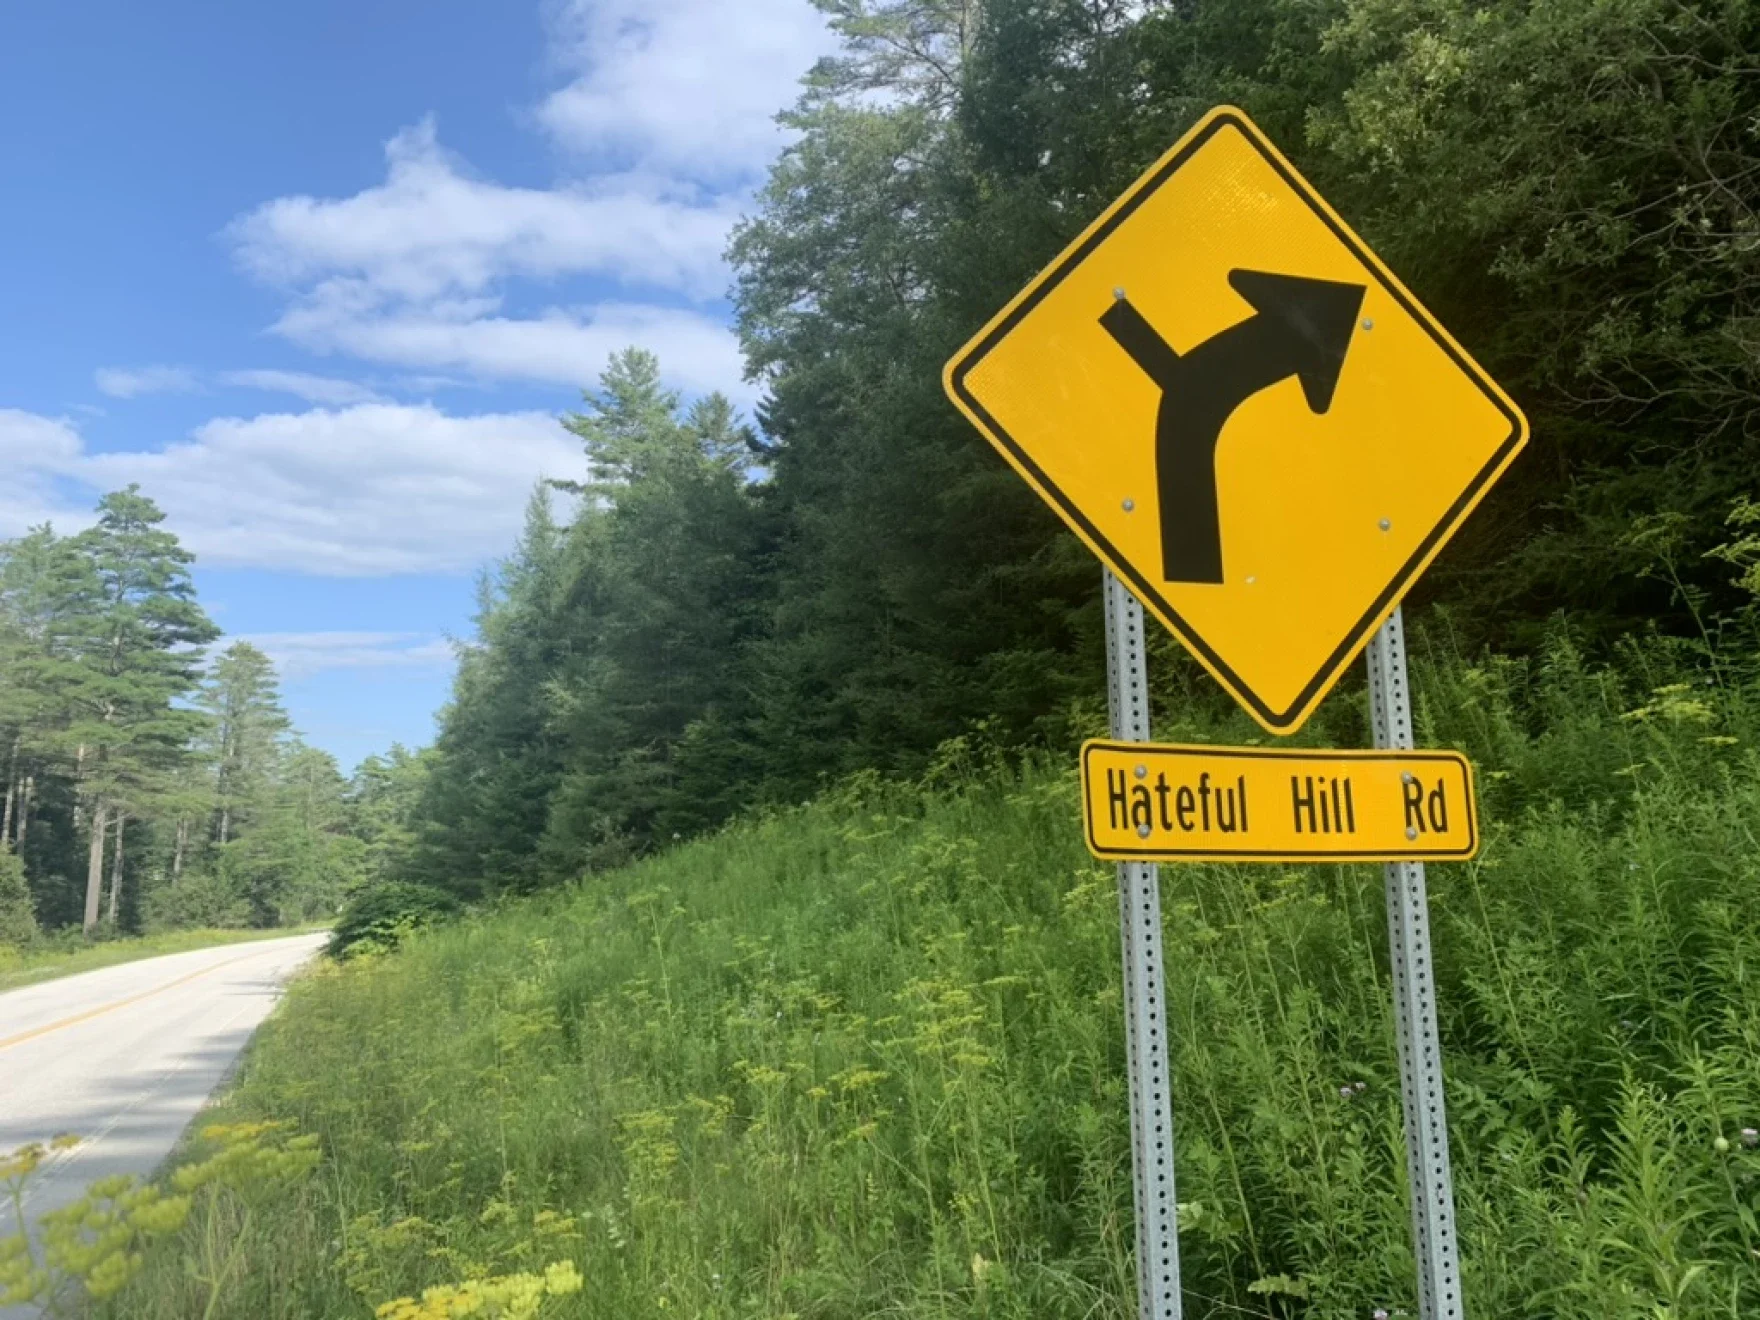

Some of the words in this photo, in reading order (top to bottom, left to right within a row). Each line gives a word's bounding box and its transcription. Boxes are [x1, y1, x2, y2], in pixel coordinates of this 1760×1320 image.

[1107, 767, 1249, 833] Hateful
[1291, 775, 1355, 833] Hill
[1402, 776, 1449, 833] Rd
